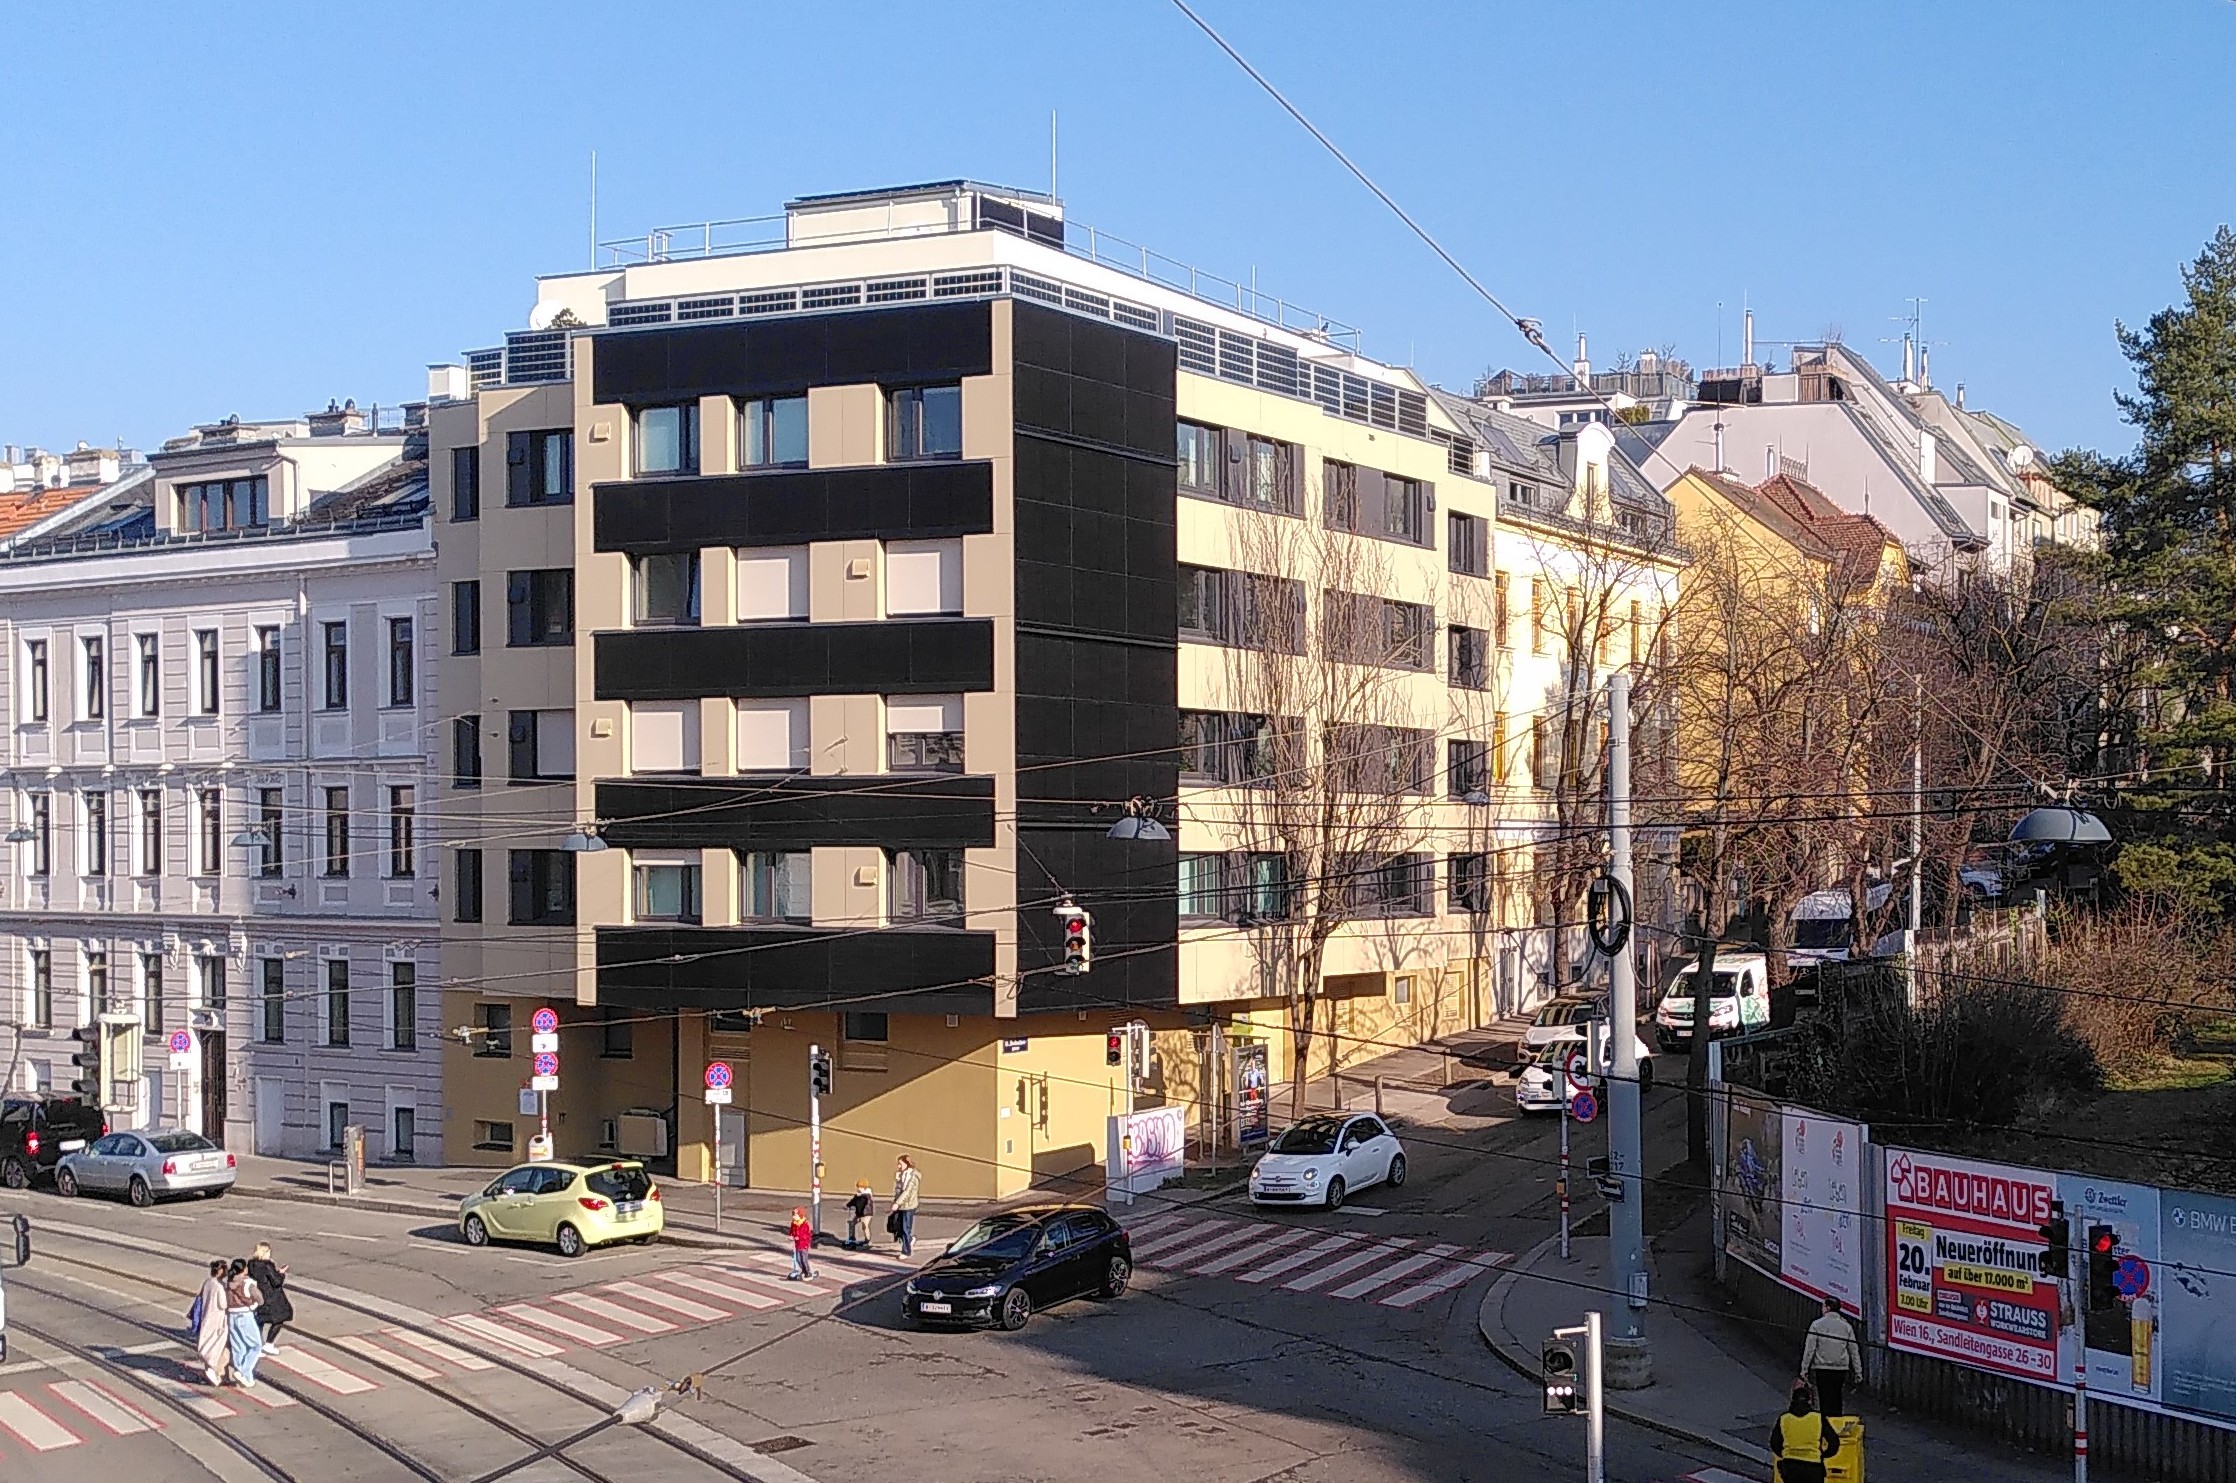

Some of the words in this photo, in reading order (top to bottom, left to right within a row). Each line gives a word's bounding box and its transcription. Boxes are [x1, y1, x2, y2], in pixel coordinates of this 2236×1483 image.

[1917, 1170, 2050, 1219] BAUHAUS
[1902, 1223, 1925, 1240] Freitag
[2191, 1211, 2227, 1231] BMW
[1899, 1243, 1930, 1276] 20.
[1936, 1235, 2048, 1278] Neueröffnung
[1899, 1274, 1930, 1292] Februar
[1948, 1267, 1962, 1279] auf
[1964, 1267, 1982, 1283] über
[1984, 1271, 2014, 1289] 17.000
[1916, 1297, 1928, 1309] Uhr
[1990, 1301, 2047, 1328] STRAUSS
[1893, 1318, 1917, 1338] Wien
[1937, 1328, 2013, 1362] Sandleitengasse
